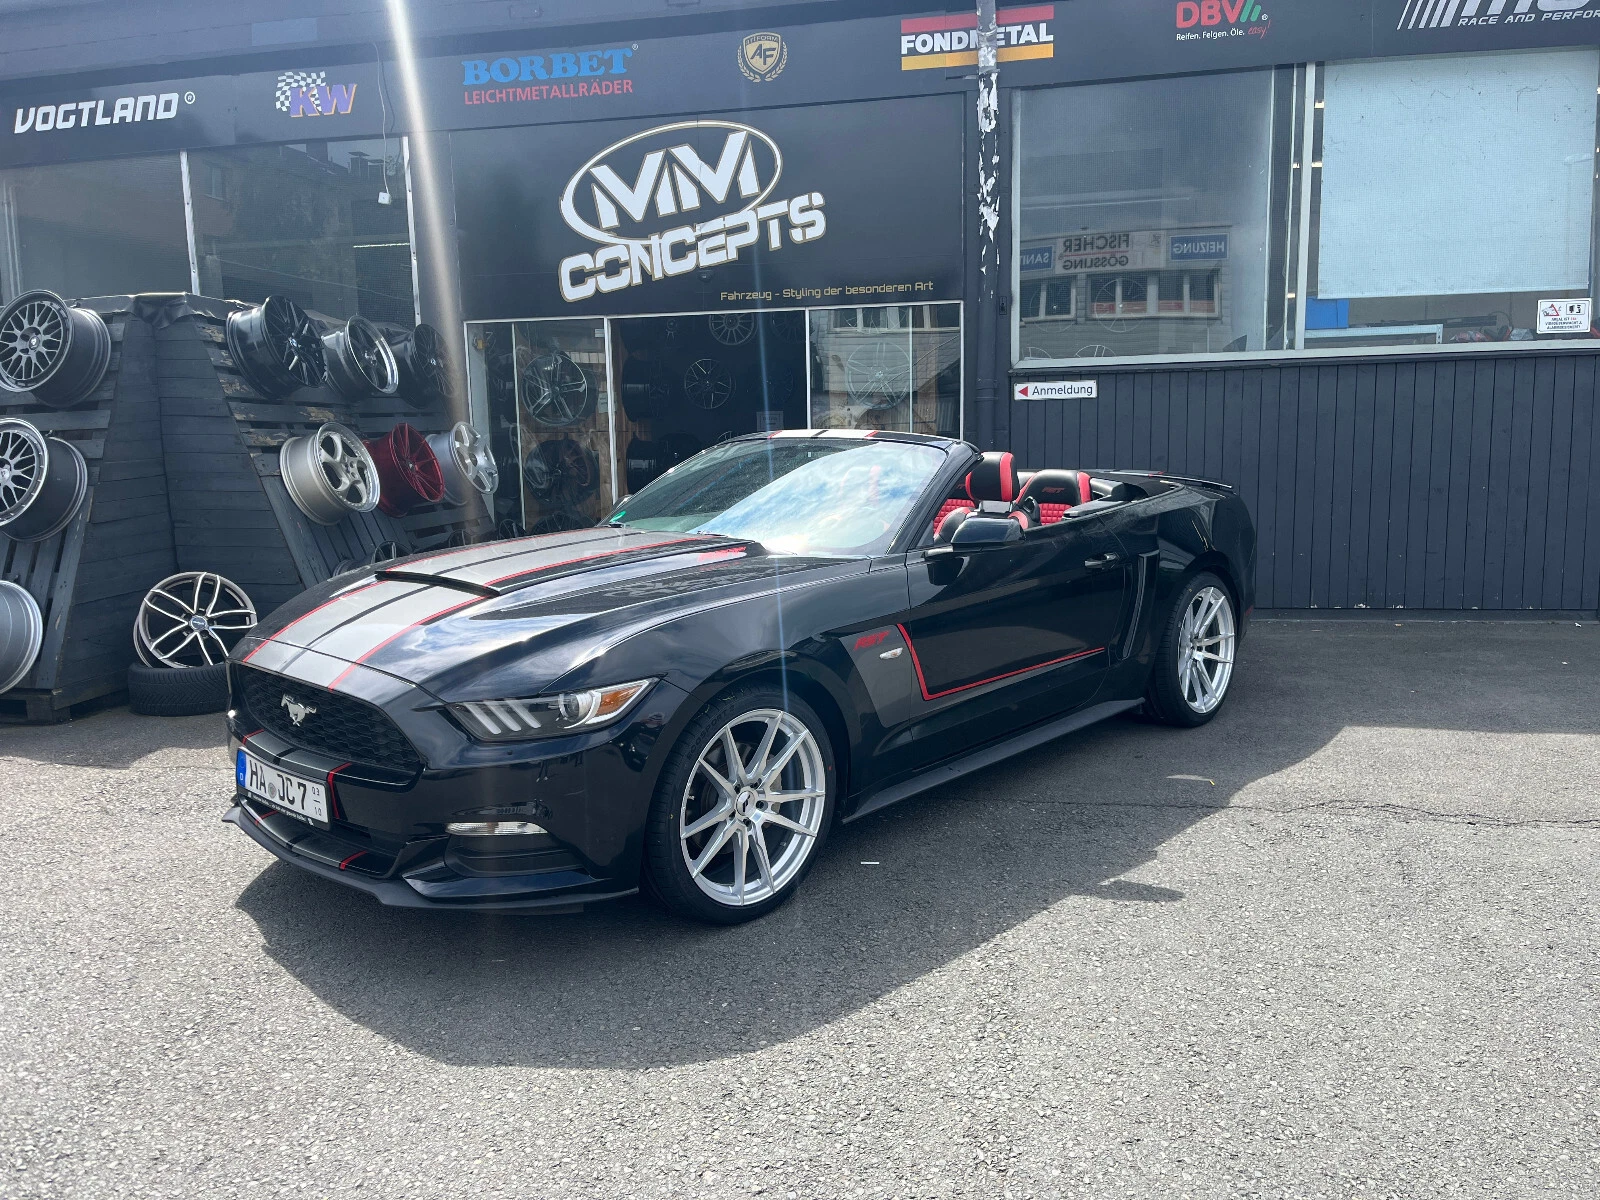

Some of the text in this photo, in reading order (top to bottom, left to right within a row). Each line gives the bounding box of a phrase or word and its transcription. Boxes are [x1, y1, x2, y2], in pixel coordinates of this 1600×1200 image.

[1176, 0, 1244, 28] DBV
[1457, 16, 1499, 26] RACE
[1504, 14, 1536, 23] AND
[1176, 33, 1201, 41] Reifen.
[1202, 30, 1228, 39] Felgen.
[461, 48, 633, 86] BORBET
[750, 43, 777, 66] AF
[289, 83, 357, 117] KW
[464, 78, 633, 105] LEICHTMETALLRÄDER
[13, 92, 179, 134] VOGTLAND
[558, 191, 827, 302] CONCEPTS
[720, 290, 772, 301] Fahrzeug
[782, 287, 822, 299] Styling
[824, 286, 843, 296] der
[845, 283, 912, 294] besonderen
[914, 281, 934, 291] Art
[1032, 384, 1093, 396] Anmeldung
[249, 759, 267, 794] HA
